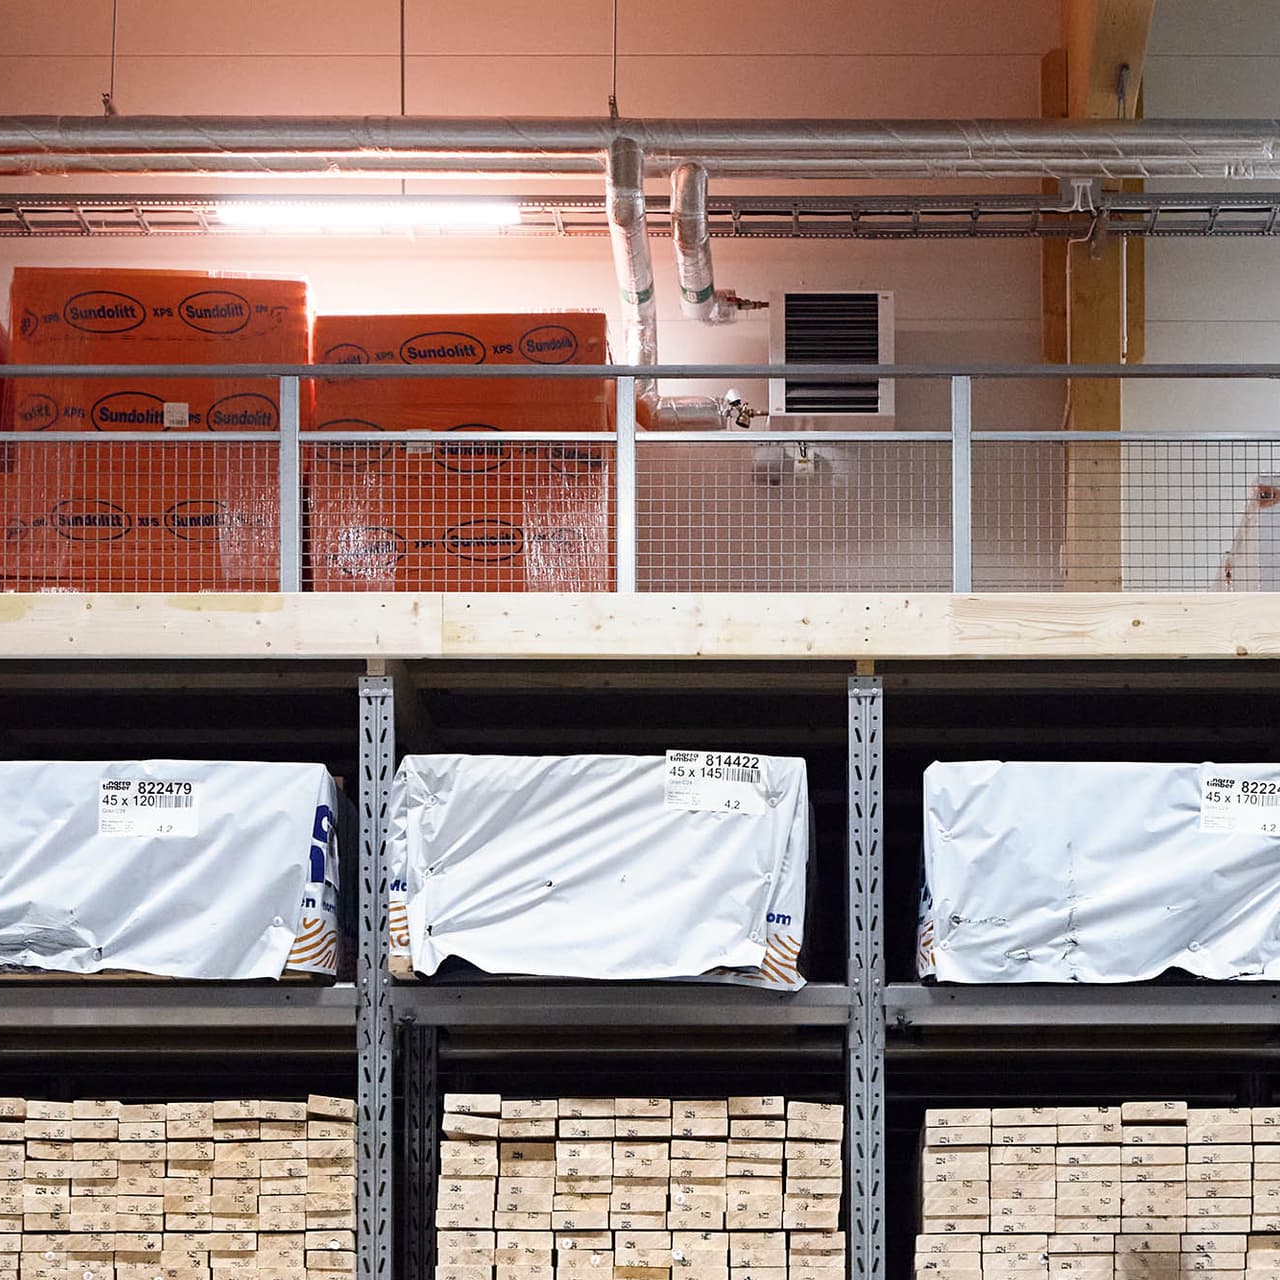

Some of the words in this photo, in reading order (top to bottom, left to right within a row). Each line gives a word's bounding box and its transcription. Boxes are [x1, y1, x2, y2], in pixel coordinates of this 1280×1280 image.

[70, 306, 136, 320] Sundolitt
[152, 308, 174, 317] XPS
[186, 303, 244, 318] Sundolitt
[407, 345, 477, 360] Sundolitt
[493, 345, 513, 355] XPS
[213, 410, 272, 426] Sundolitt
[706, 755, 759, 769] 814422
[669, 767, 685, 777] 45
[689, 769, 695, 777] x
[700, 767, 722, 778] 145
[138, 782, 192, 795] 822479
[102, 795, 118, 806] 45
[122, 798, 128, 806] x
[133, 795, 155, 806] 120
[1205, 792, 1222, 802] 45
[1224, 795, 1231, 803] x
[1237, 794, 1258, 805] 170
